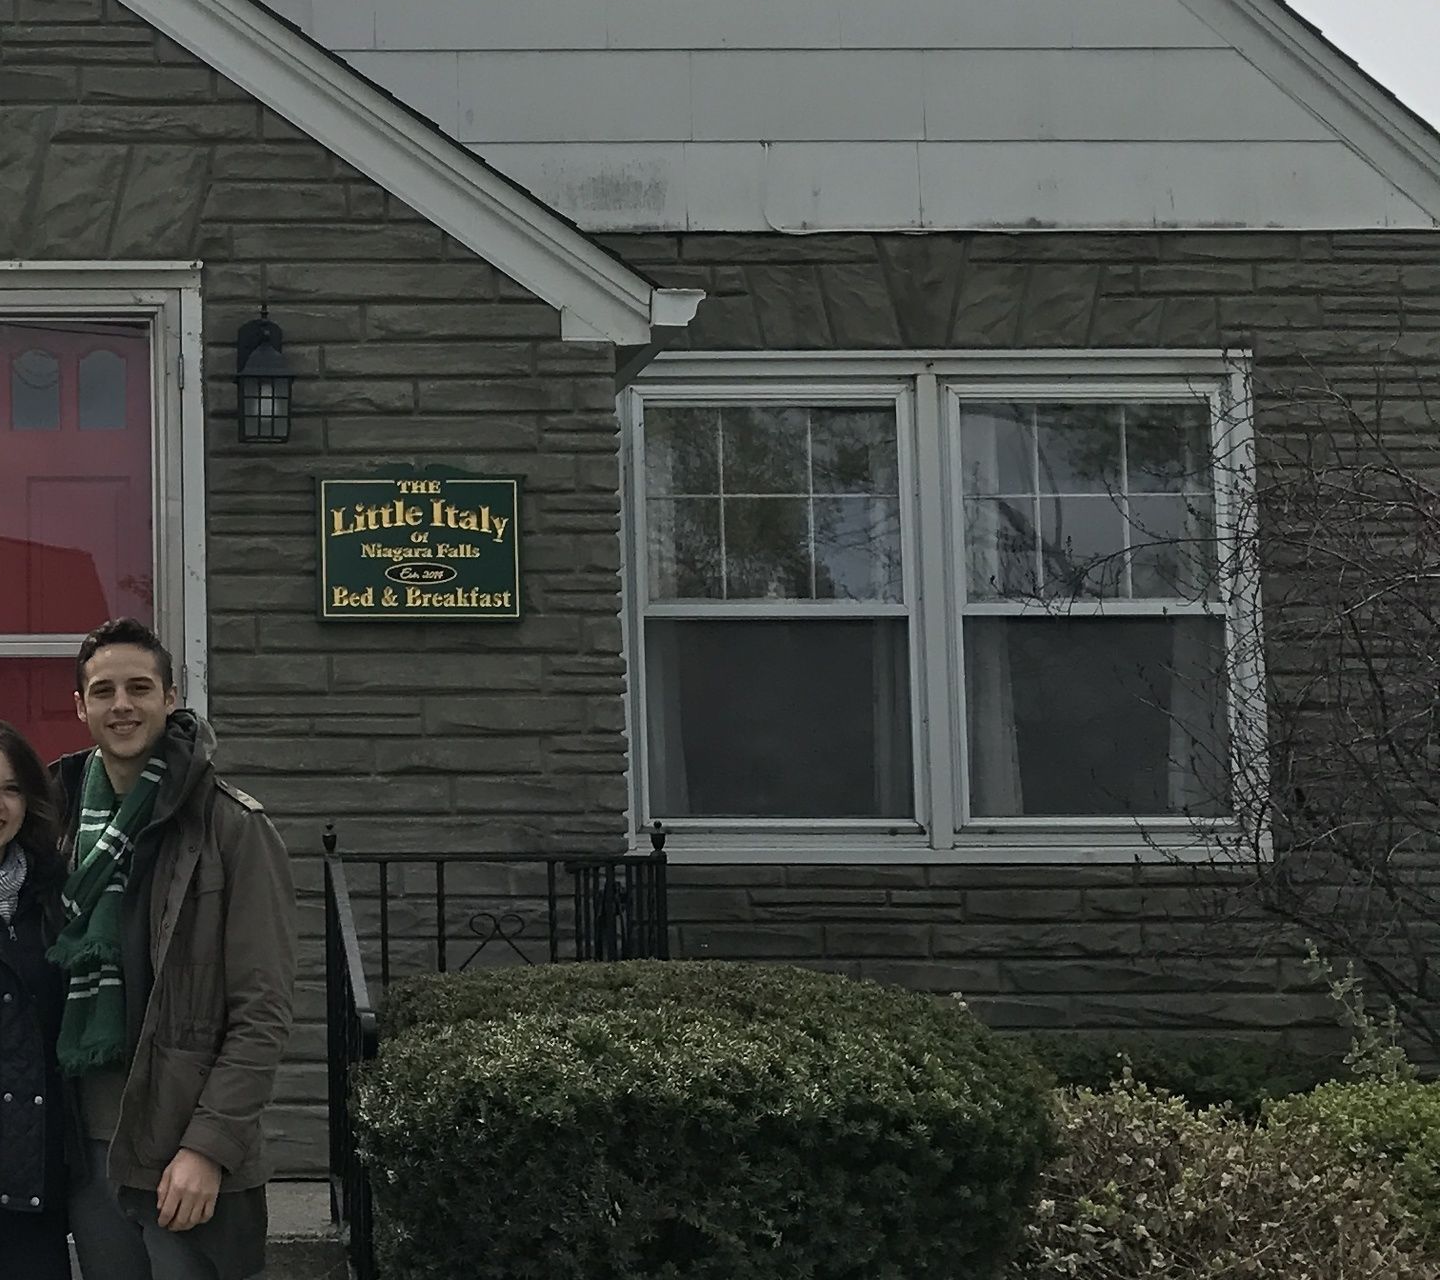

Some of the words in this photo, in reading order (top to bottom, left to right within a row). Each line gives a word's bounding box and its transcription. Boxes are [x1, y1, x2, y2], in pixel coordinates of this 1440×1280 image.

[396, 479, 441, 494] THE
[330, 498, 424, 537] Little
[429, 498, 510, 543] Italy
[360, 543, 433, 562] Niagara
[436, 543, 481, 558] Falls
[331, 586, 375, 607] Bed
[381, 586, 399, 607] &
[405, 586, 512, 608] Breakfast
